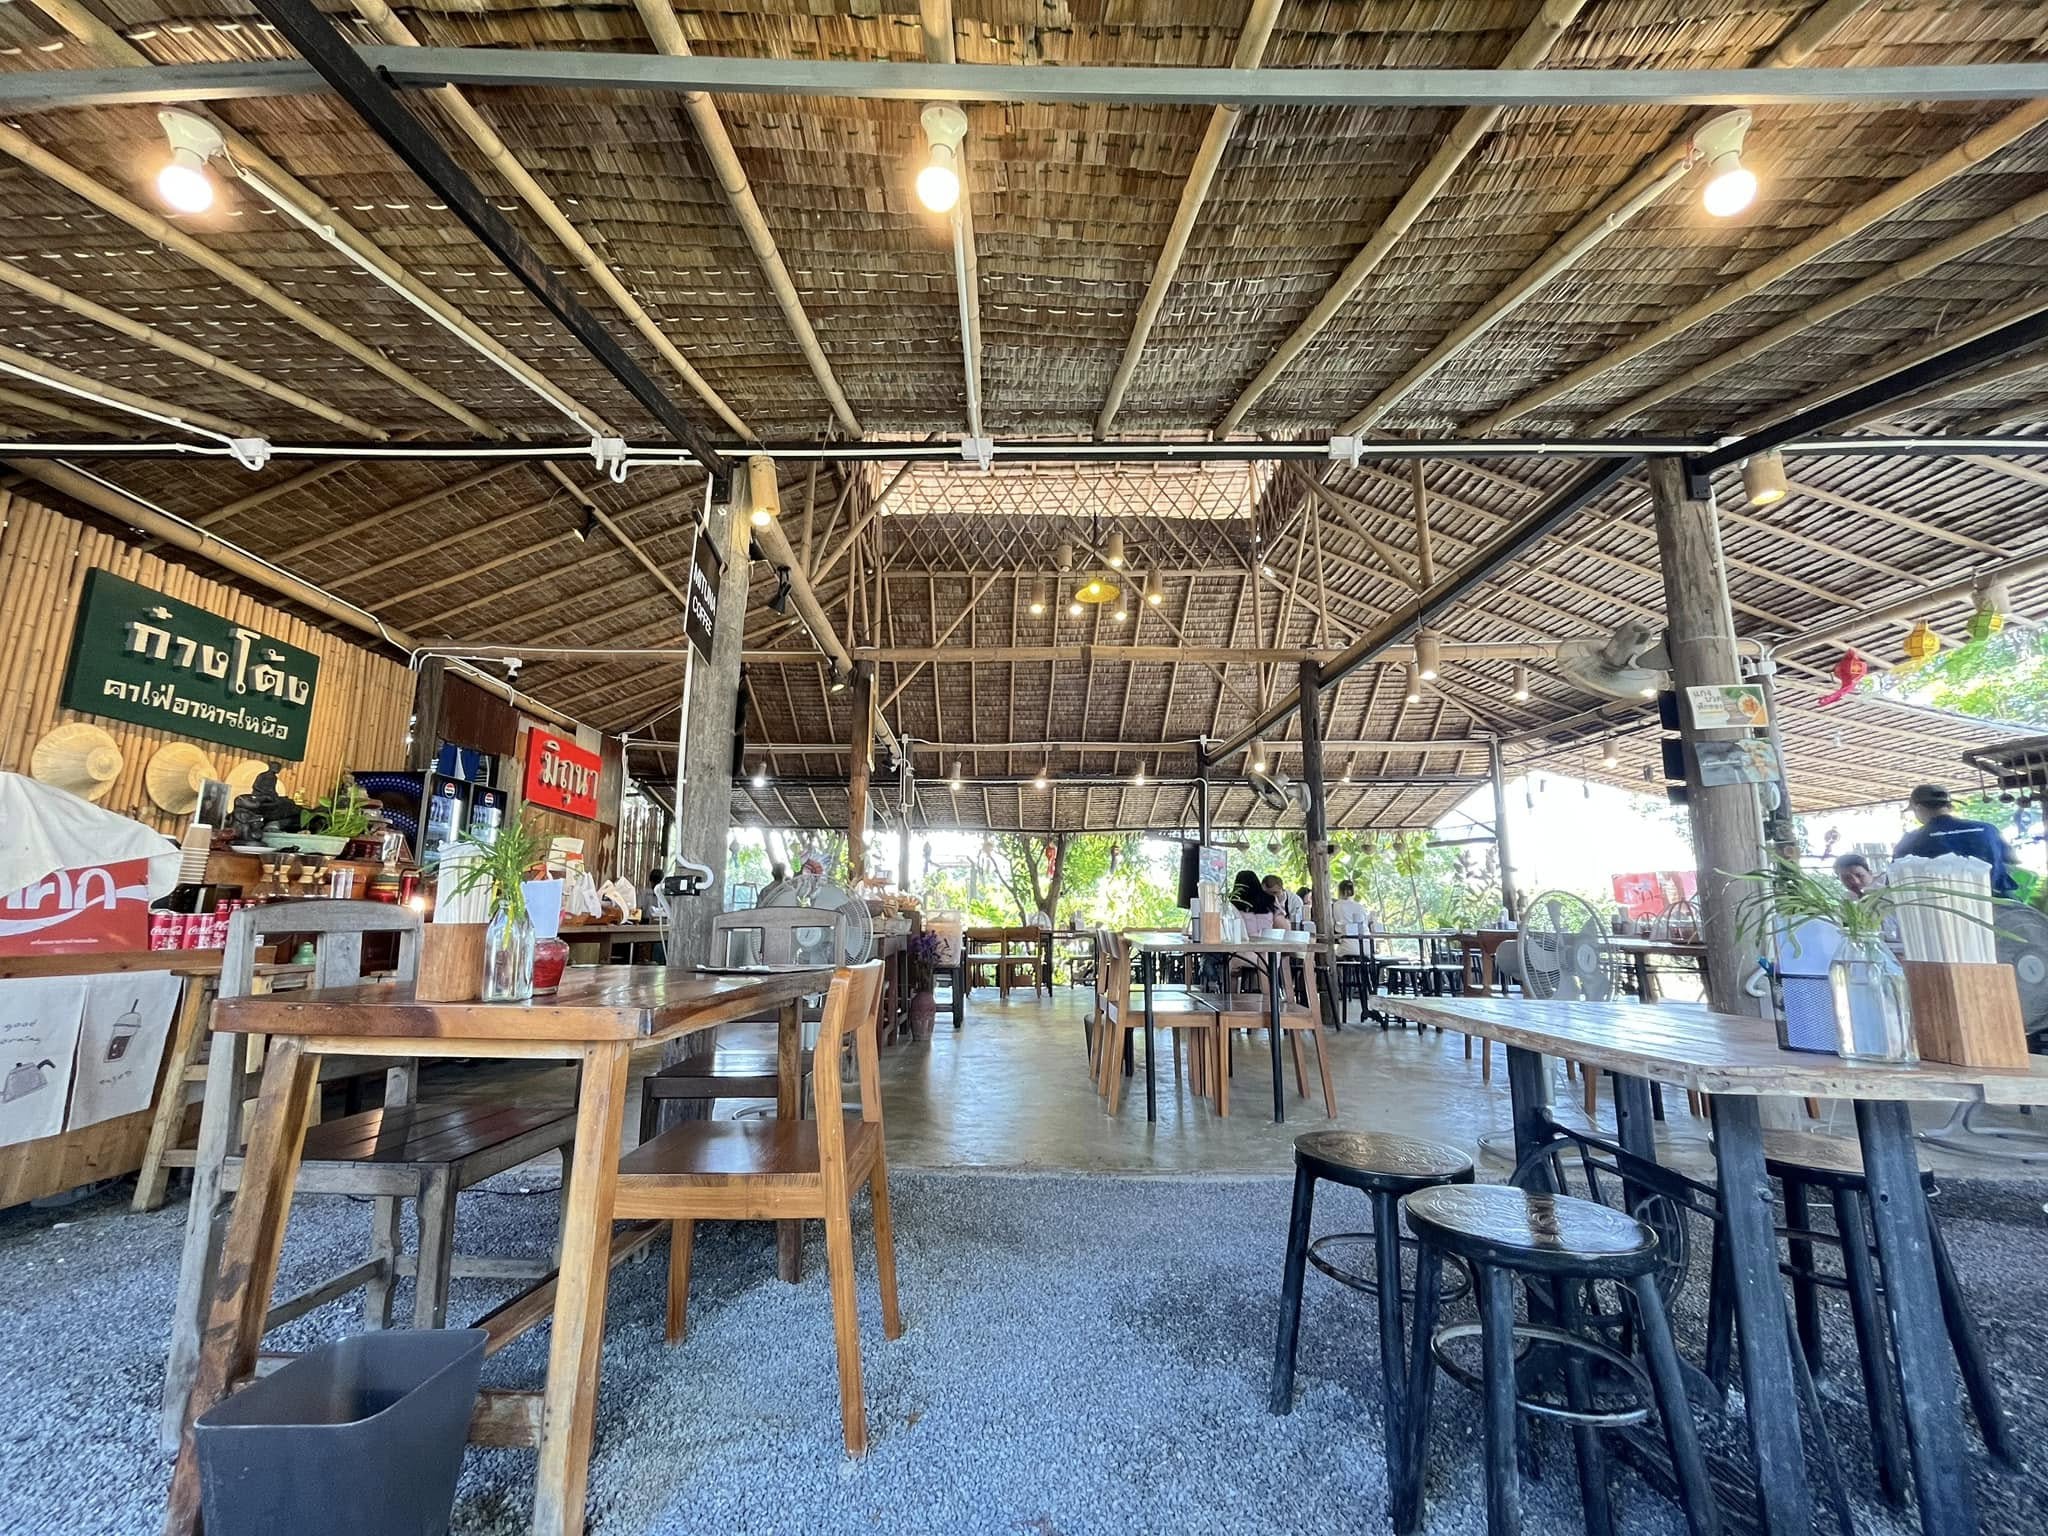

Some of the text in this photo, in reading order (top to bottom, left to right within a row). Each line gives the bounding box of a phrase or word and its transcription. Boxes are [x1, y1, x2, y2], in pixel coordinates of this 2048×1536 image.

[692, 595, 713, 637] COFFEE
[693, 562, 717, 617] MITUNA
[128, 605, 310, 706] ก๋างโต้ง
